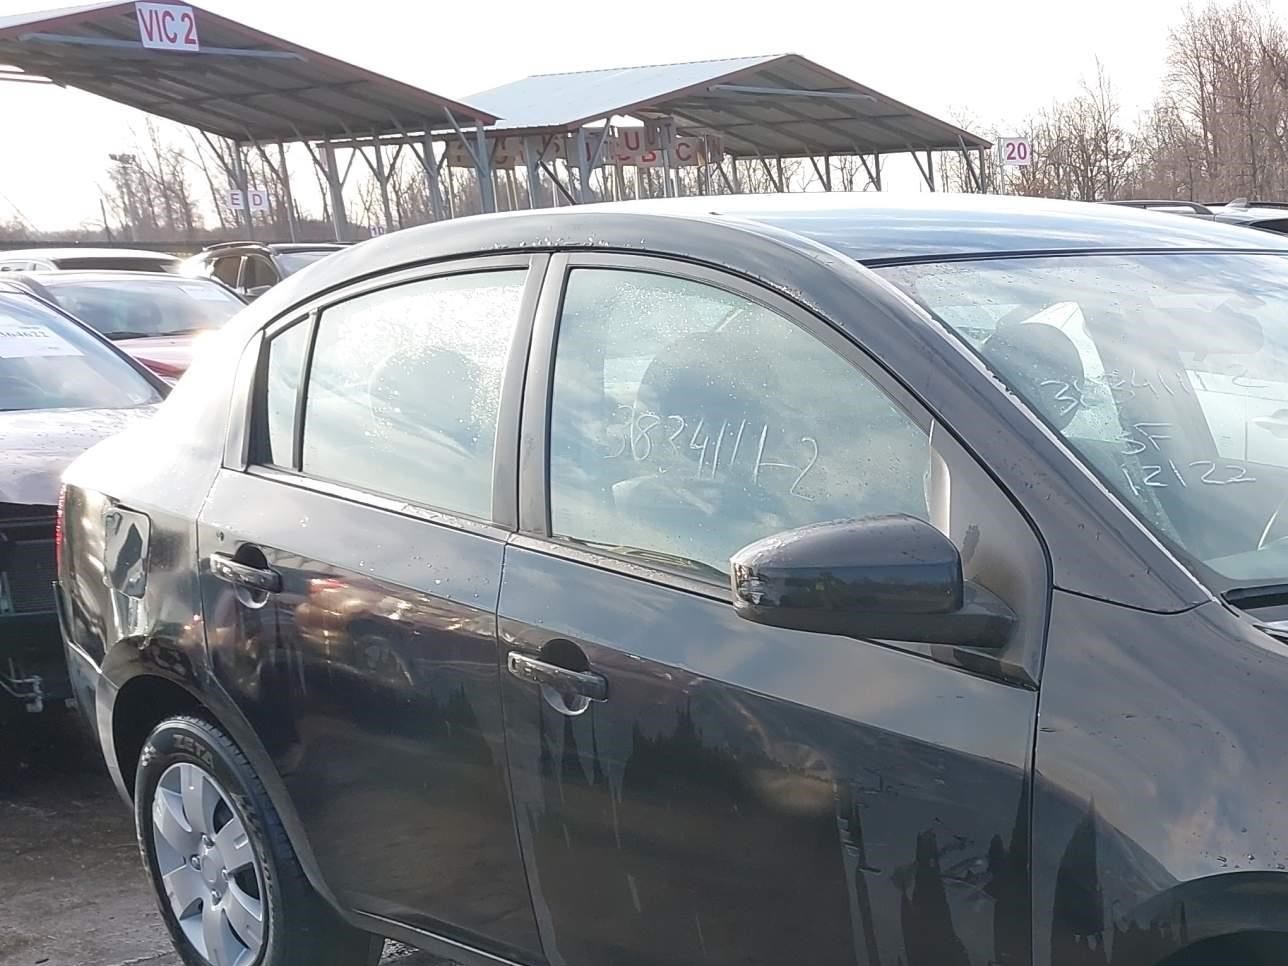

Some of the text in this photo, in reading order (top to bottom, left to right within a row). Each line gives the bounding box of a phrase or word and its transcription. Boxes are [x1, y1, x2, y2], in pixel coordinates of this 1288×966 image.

[138, 8, 197, 44] VIC 2
[1006, 142, 1027, 160] 20
[230, 192, 241, 206] E
[252, 193, 263, 207] D
[173, 734, 214, 768] ZETA
